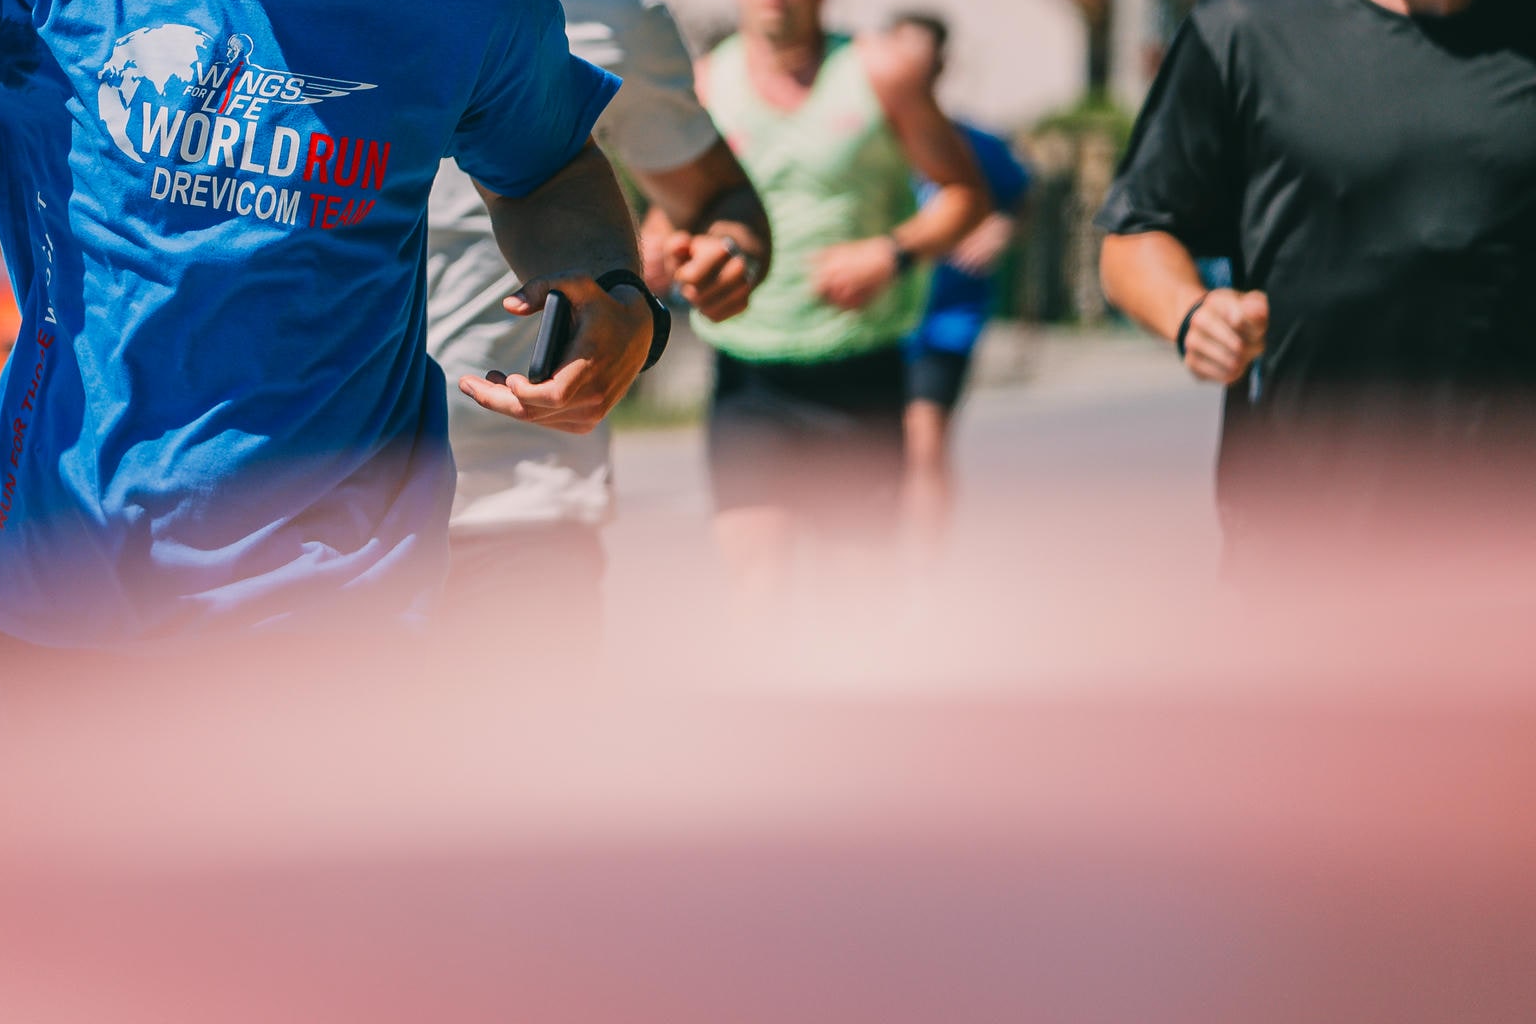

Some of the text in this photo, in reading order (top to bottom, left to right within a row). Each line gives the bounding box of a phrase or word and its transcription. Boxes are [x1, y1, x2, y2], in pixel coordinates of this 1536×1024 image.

[183, 85, 270, 121] FOR LIFE
[195, 62, 305, 100] WINGS
[141, 102, 392, 192] WORLD RUN
[150, 166, 376, 230] DREVICOM TEAM
[10, 418, 29, 469] FOR
